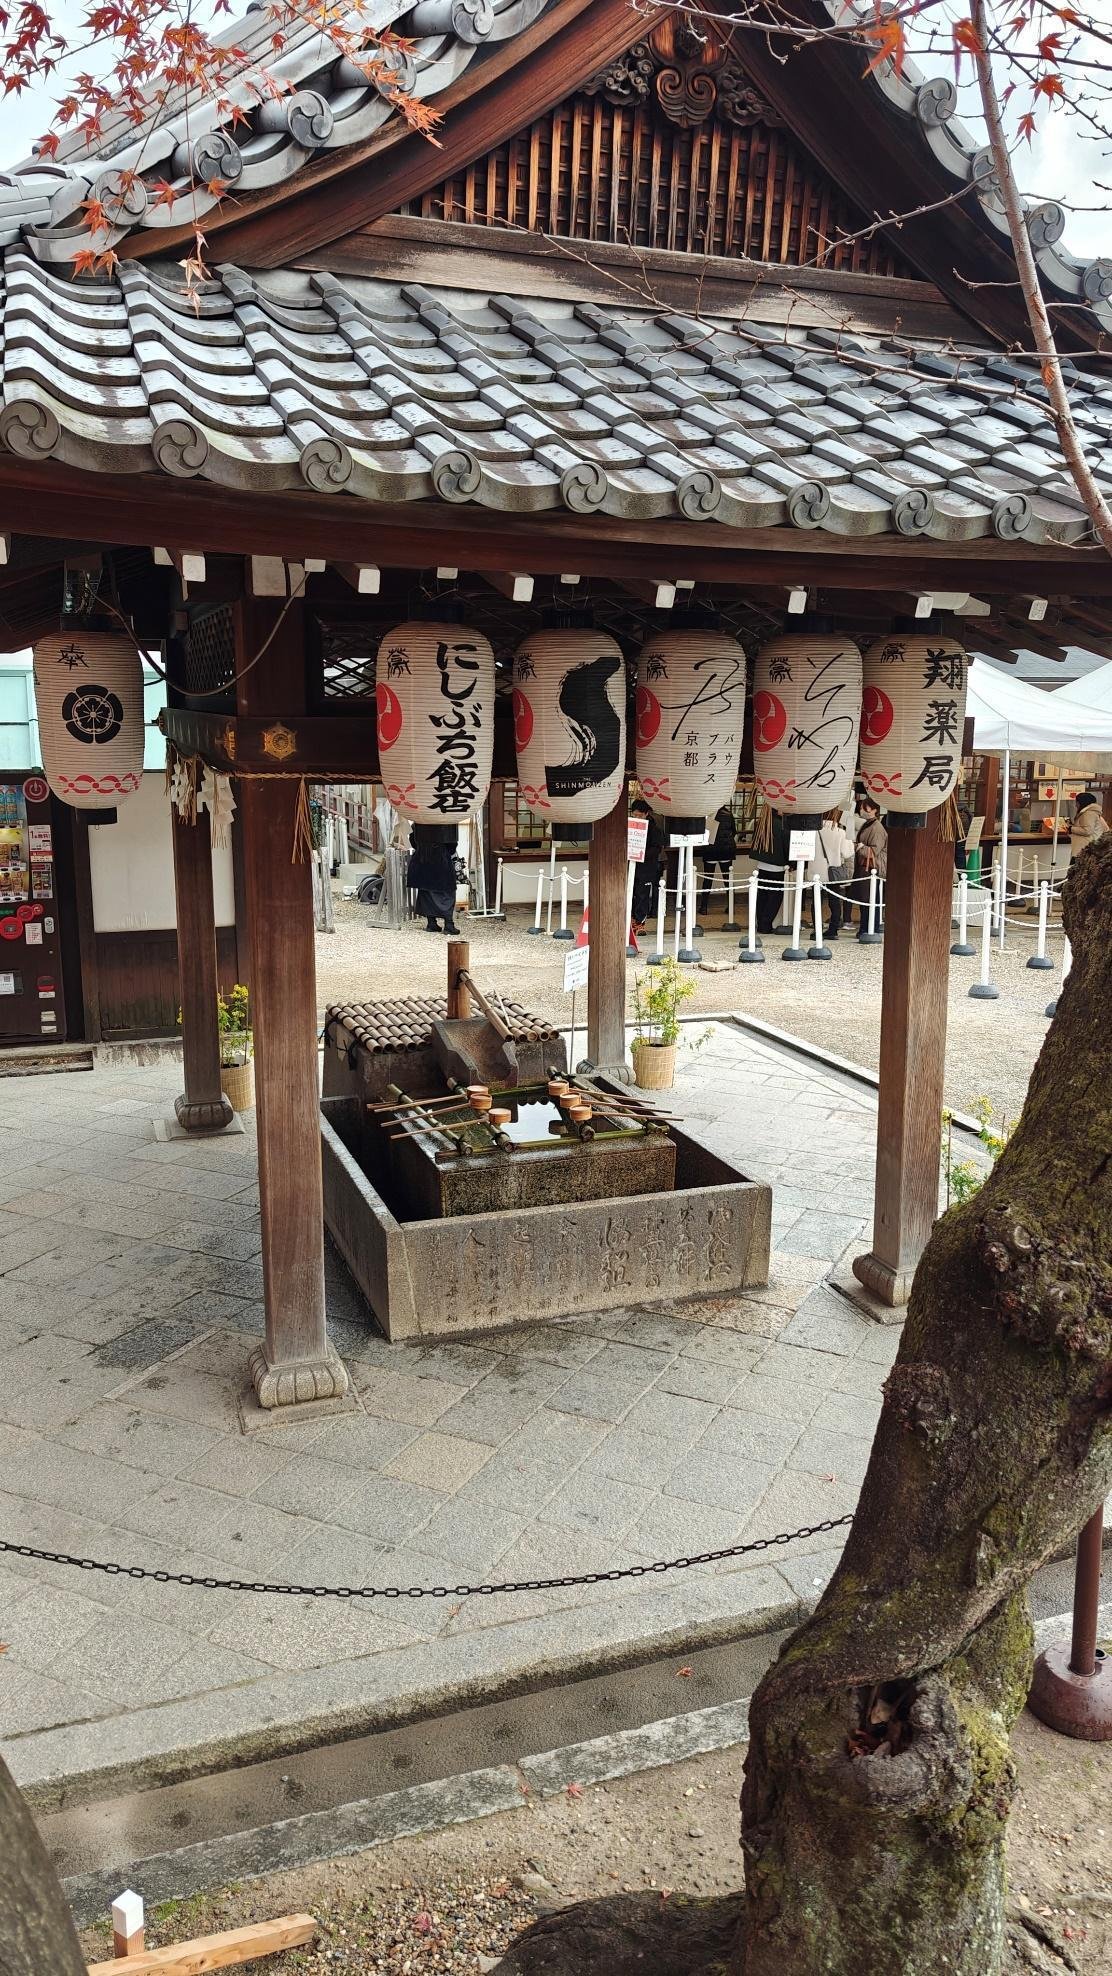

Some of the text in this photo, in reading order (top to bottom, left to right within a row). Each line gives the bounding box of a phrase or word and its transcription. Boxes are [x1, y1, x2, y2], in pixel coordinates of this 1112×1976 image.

[425, 640, 484, 815] にしぶち飯店
[683, 731, 700, 767] 京都
[909, 647, 964, 792] 翔薬局
[555, 781, 612, 789] SHINMONZEN
